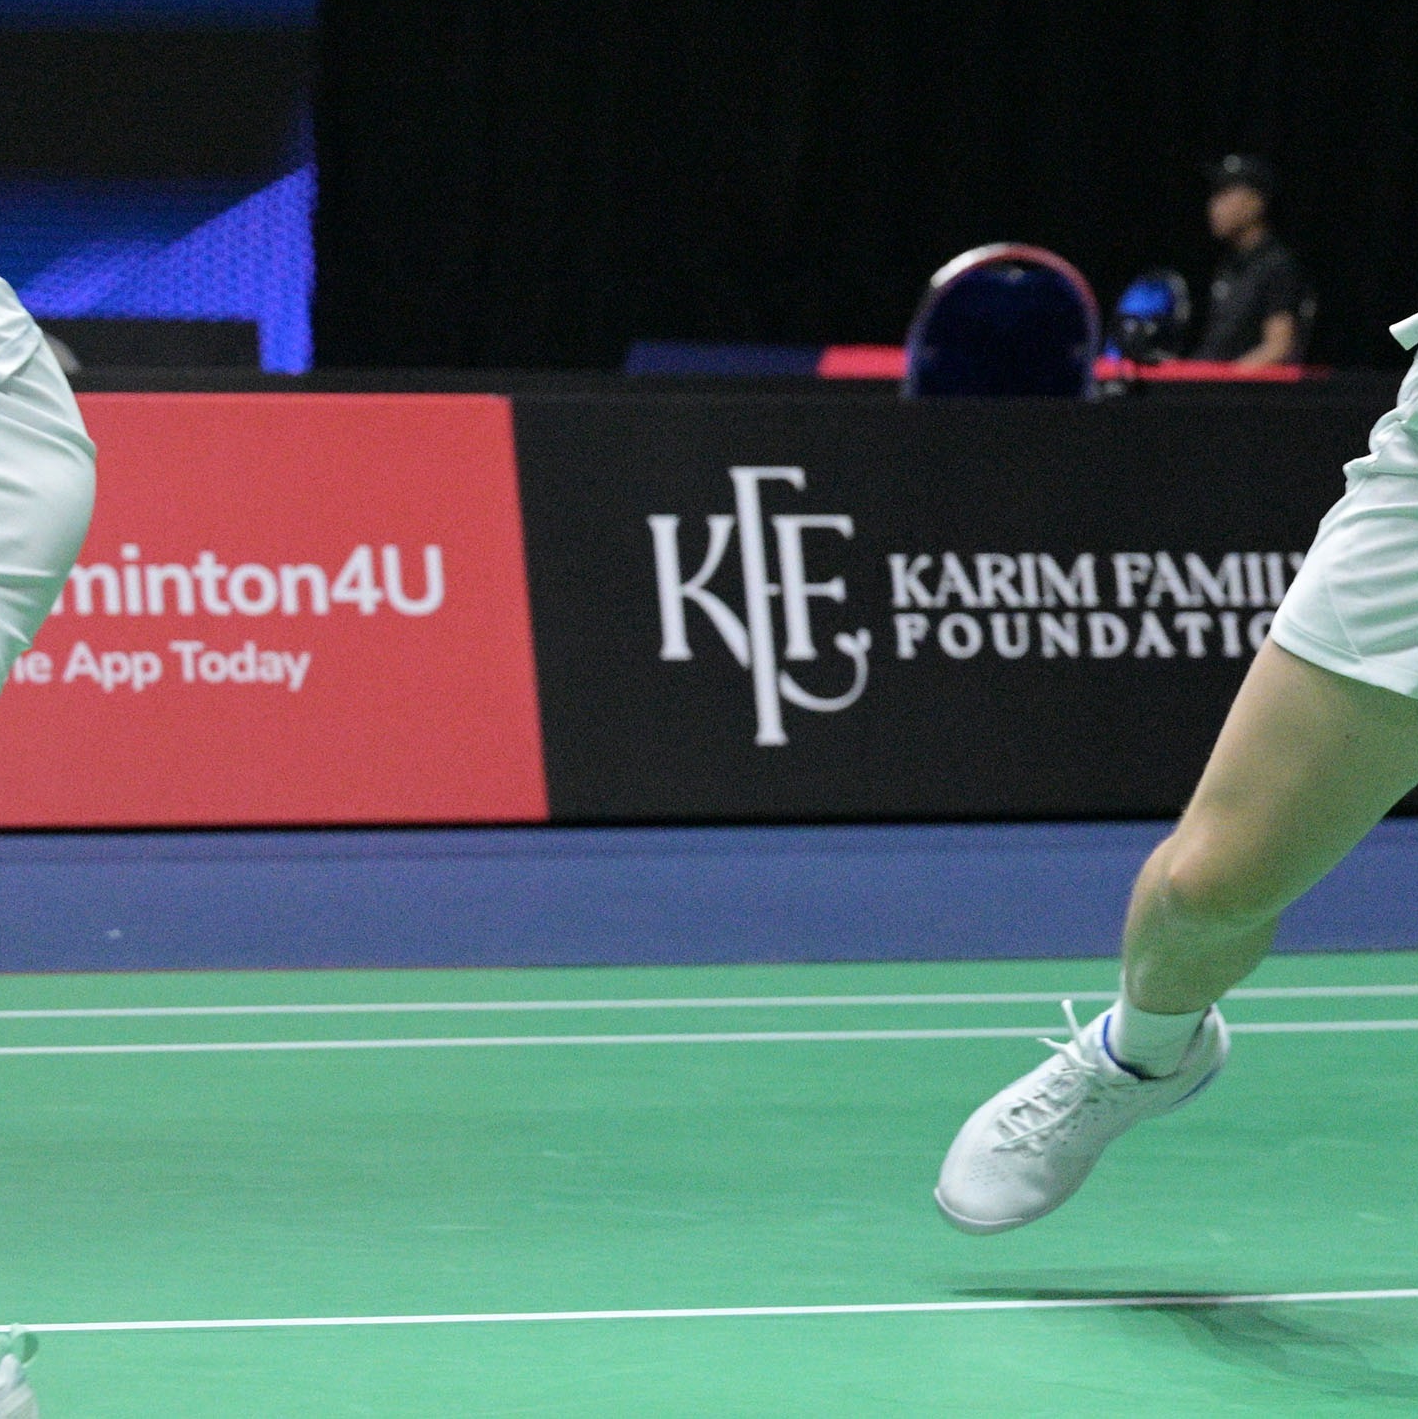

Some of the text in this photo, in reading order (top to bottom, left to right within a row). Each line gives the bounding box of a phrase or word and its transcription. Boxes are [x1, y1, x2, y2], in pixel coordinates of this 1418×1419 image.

[886, 551, 1100, 609] KARIM
[63, 640, 164, 693] App
[169, 639, 312, 693] Today
